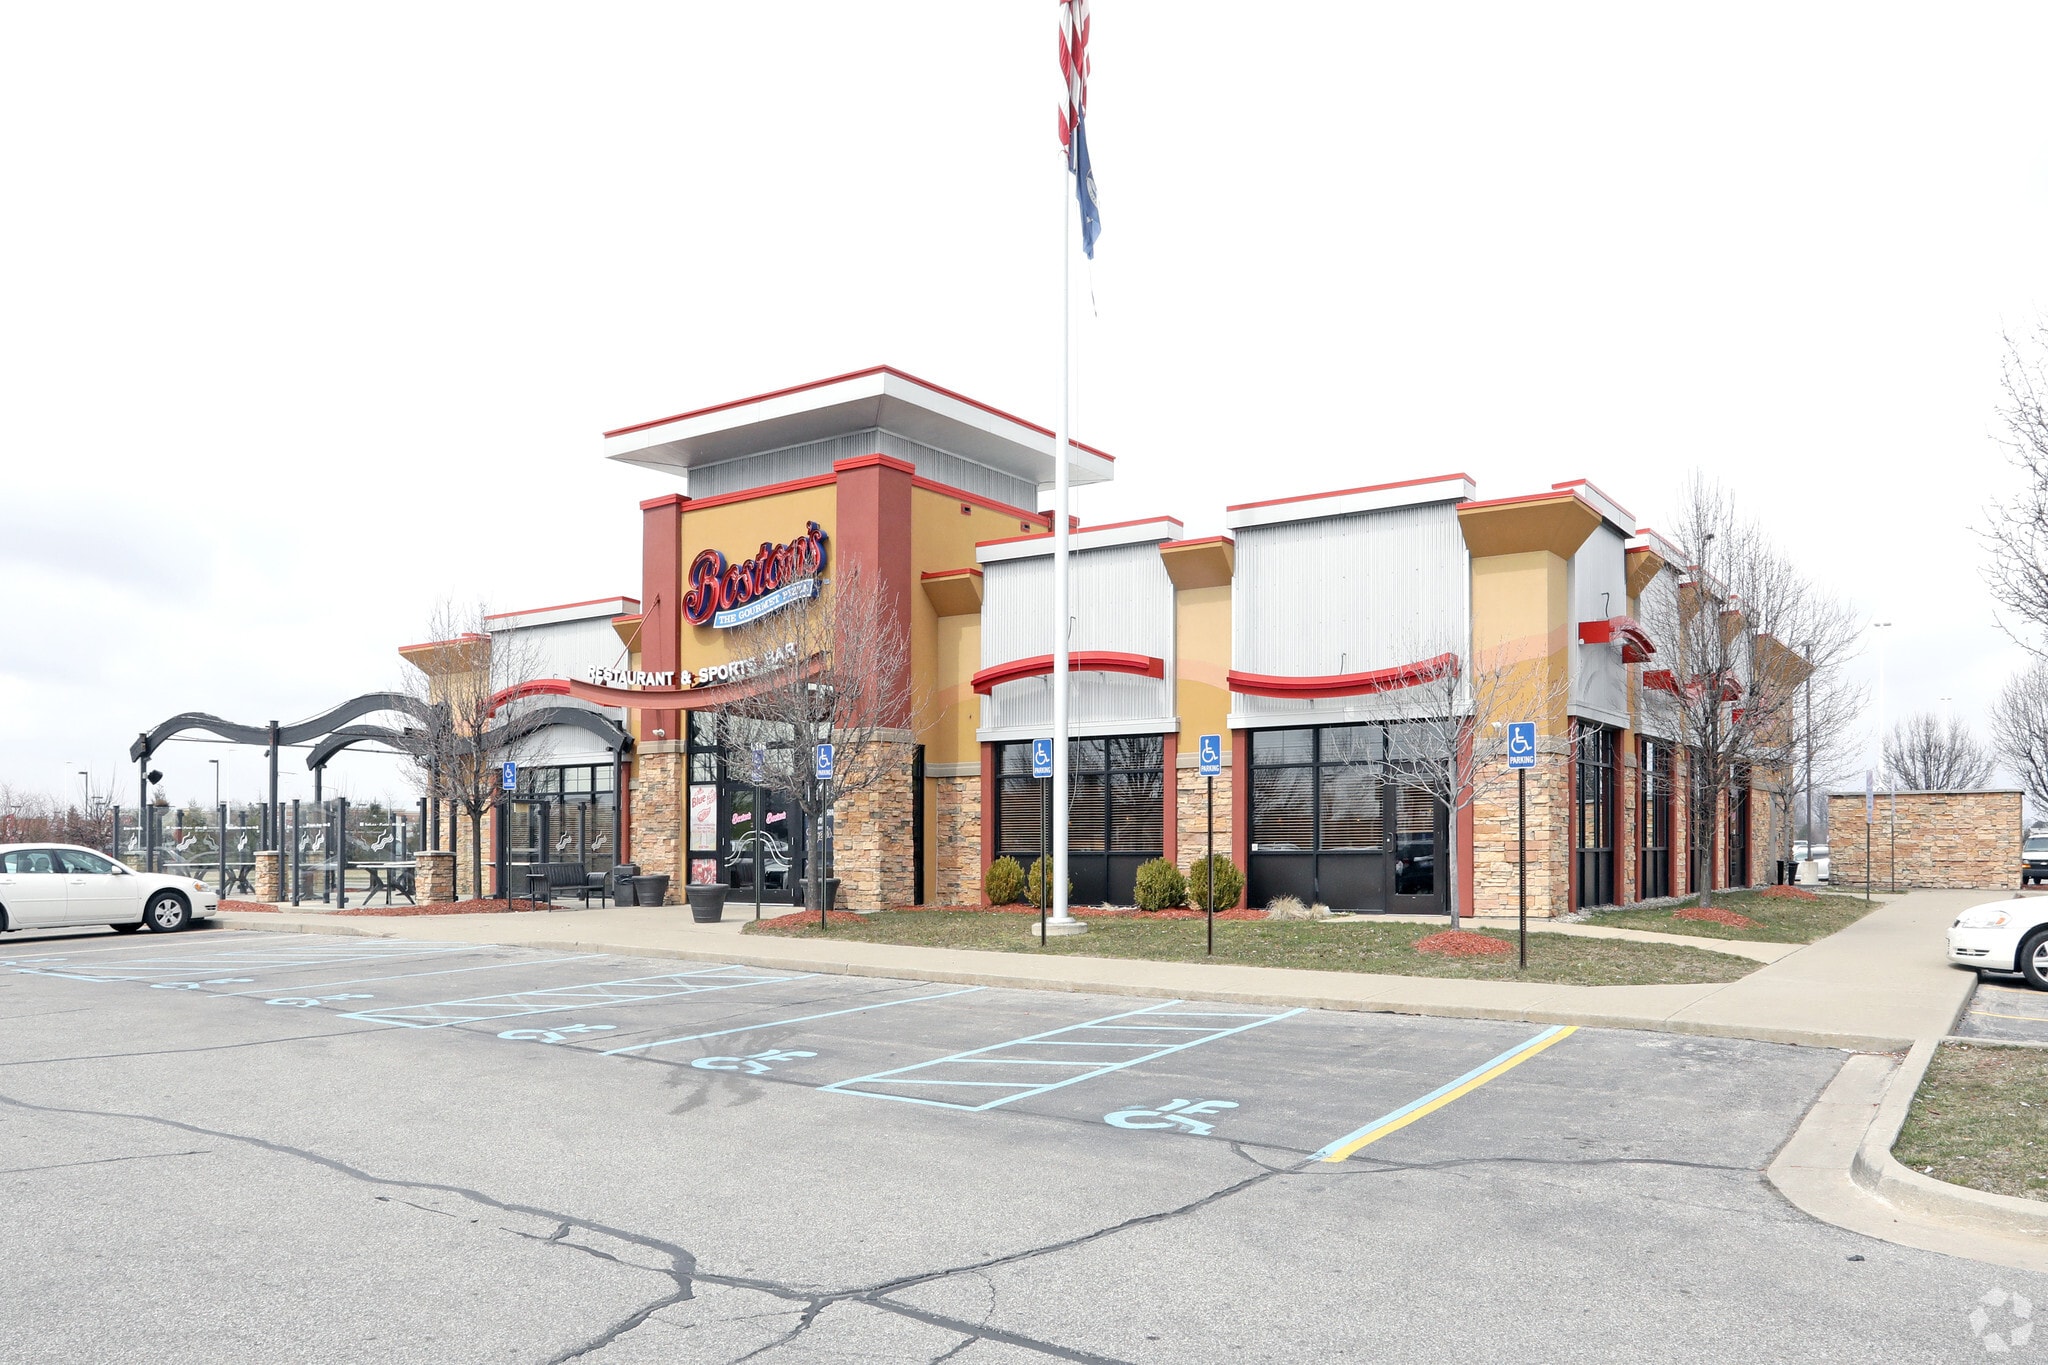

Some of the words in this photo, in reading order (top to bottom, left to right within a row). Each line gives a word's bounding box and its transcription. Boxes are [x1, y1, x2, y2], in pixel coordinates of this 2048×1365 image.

[682, 520, 828, 626] Boston's
[718, 614, 737, 625] THE
[738, 595, 780, 620] GOURMET
[587, 664, 675, 687] RESTAURANT
[680, 669, 692, 686] &
[698, 657, 758, 683] SPORTS
[764, 642, 798, 663] BAR
[1509, 755, 1534, 765] PARKING
